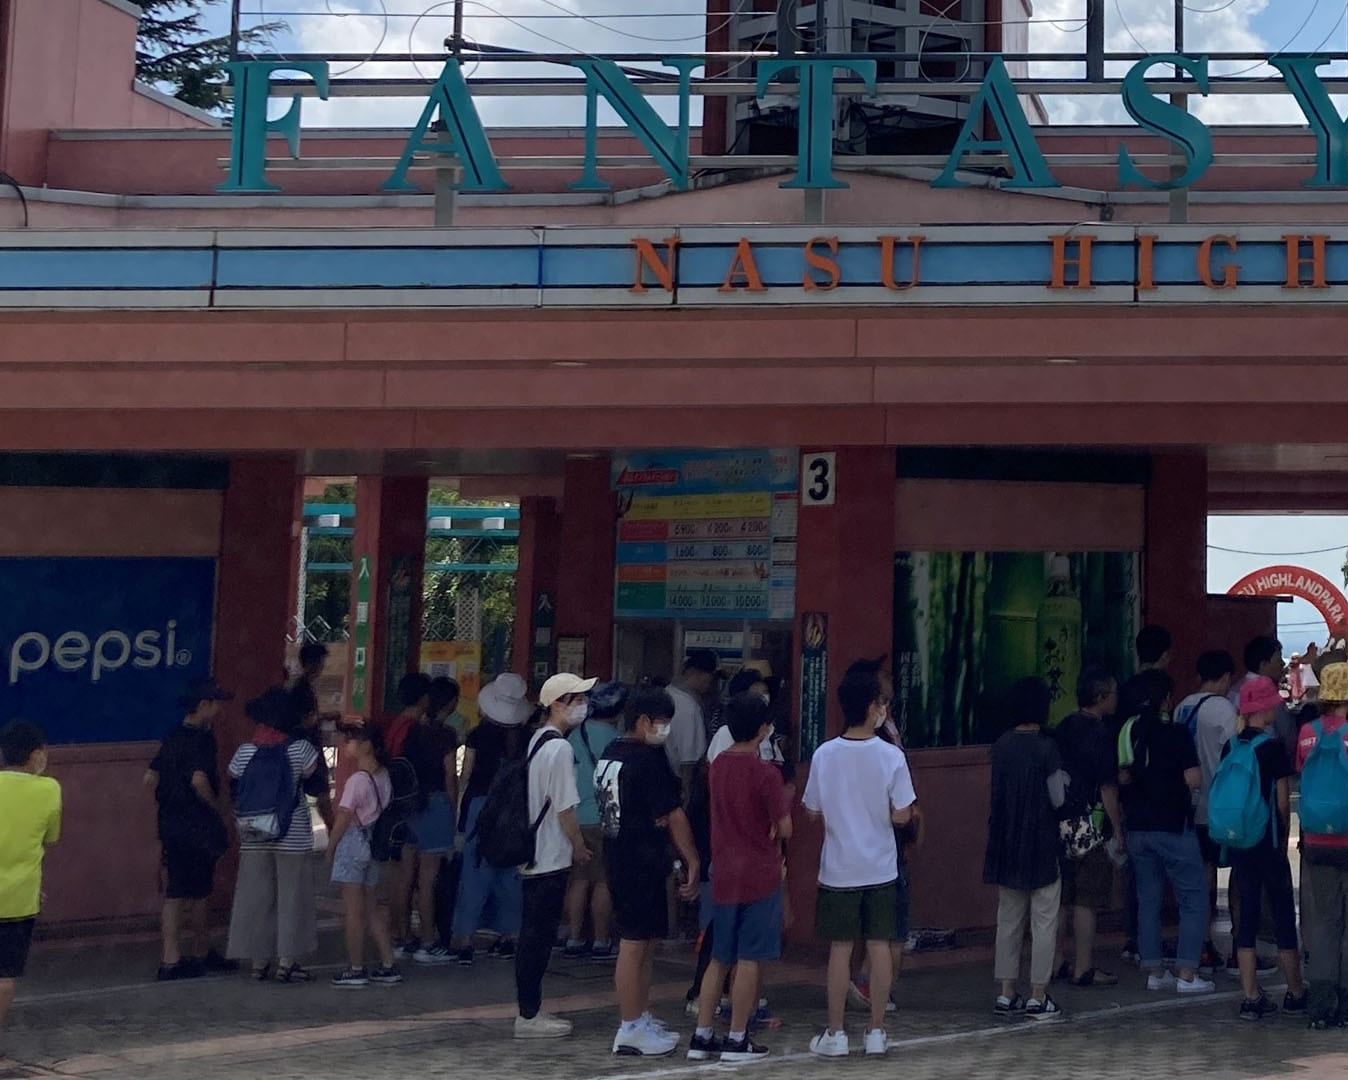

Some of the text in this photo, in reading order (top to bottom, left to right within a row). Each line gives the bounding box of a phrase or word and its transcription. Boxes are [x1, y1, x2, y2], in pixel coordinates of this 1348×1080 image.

[629, 235, 926, 292] NASU
[808, 457, 829, 500] 3
[1256, 573, 1347, 624] HIGHLANDPARK
[9, 619, 177, 684] pepsi
